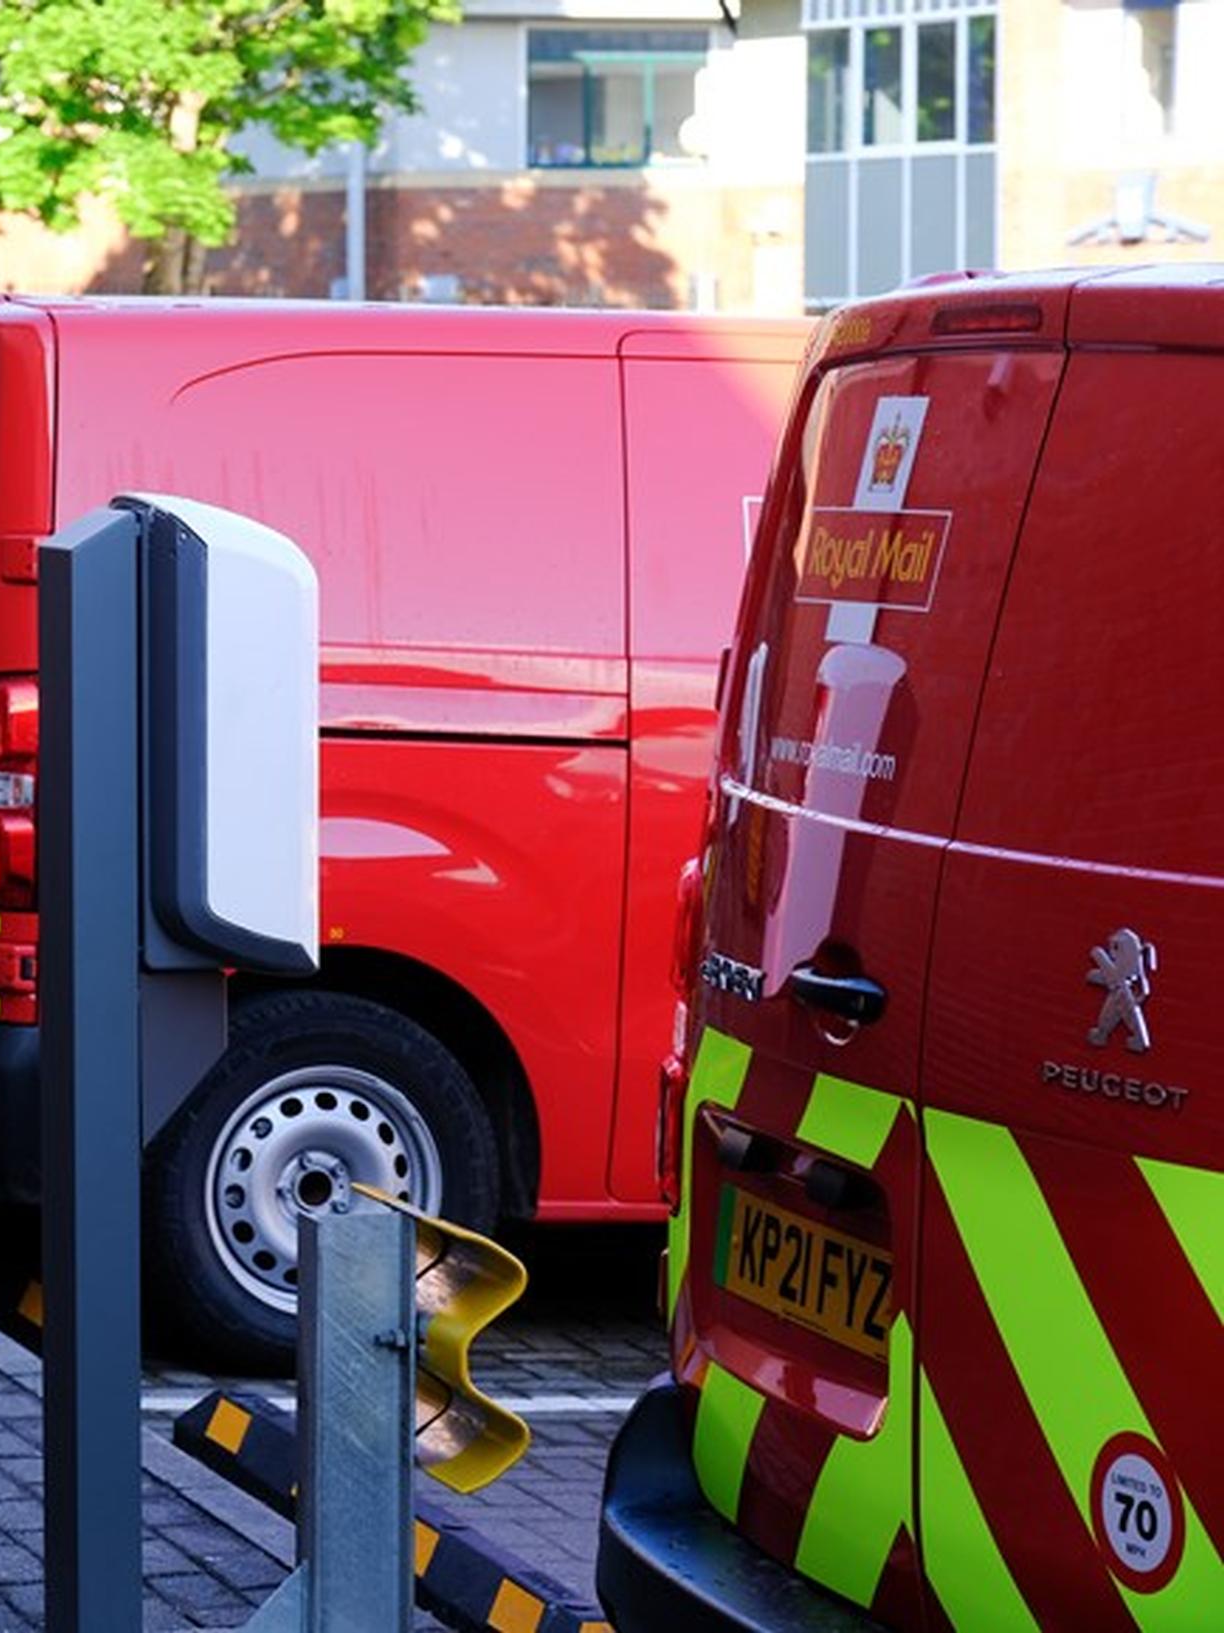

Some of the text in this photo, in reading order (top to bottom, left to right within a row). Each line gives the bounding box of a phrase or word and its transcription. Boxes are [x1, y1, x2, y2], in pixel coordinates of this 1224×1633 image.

[807, 526, 936, 590] Royal Mail
[770, 737, 896, 780] www.royalmail.com
[1041, 1060, 1189, 1110] PEUGEOT
[739, 1204, 893, 1341] KP21 FYZ
[1114, 1491, 1158, 1541] 70
